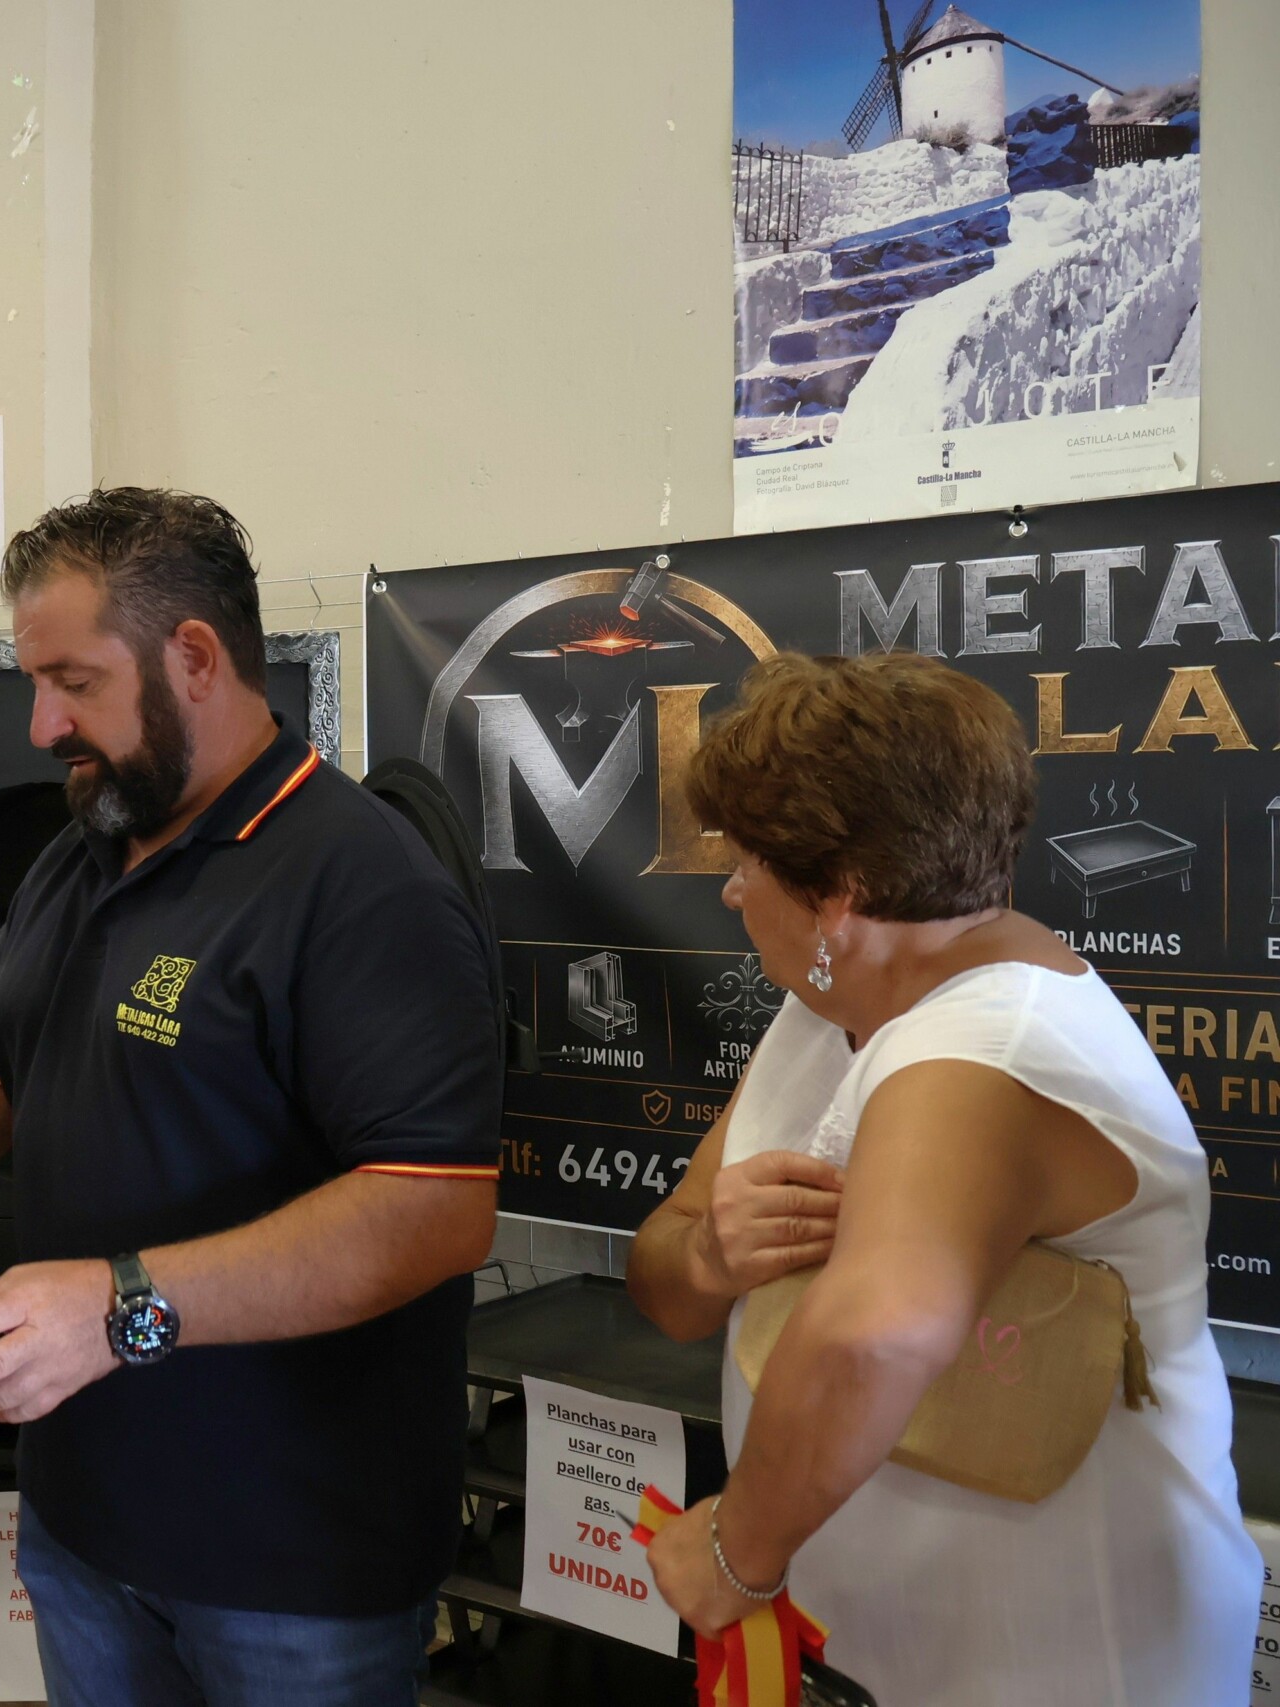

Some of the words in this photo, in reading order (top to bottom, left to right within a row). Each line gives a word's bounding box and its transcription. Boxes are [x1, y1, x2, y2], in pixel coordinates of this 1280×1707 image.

[1066, 432, 1130, 448] CASTILLA-LA
[1132, 425, 1176, 440] MANCHA
[756, 466, 781, 477] Campo
[782, 464, 791, 473] de
[792, 461, 823, 472] Criptana
[756, 475, 781, 486] Ciudad
[782, 474, 798, 484] Real
[917, 472, 953, 486] Castilla-La
[954, 469, 982, 481] Mancha
[795, 481, 815, 491] David
[1028, 662, 1280, 757] LA
[141, 1028, 157, 1041] 422
[157, 1033, 177, 1047] 200
[559, 1045, 644, 1069] AUMINIO
[720, 1041, 751, 1060] FOR
[547, 1402, 616, 1433] Planchas
[620, 1423, 657, 1443] para
[568, 1435, 602, 1455] usar
[606, 1445, 635, 1464] con
[557, 1459, 622, 1488] paellero
[625, 1475, 646, 1494] de
[584, 1494, 616, 1515] gas.
[576, 1521, 622, 1553] 70€
[548, 1552, 649, 1602] UNIDAD
